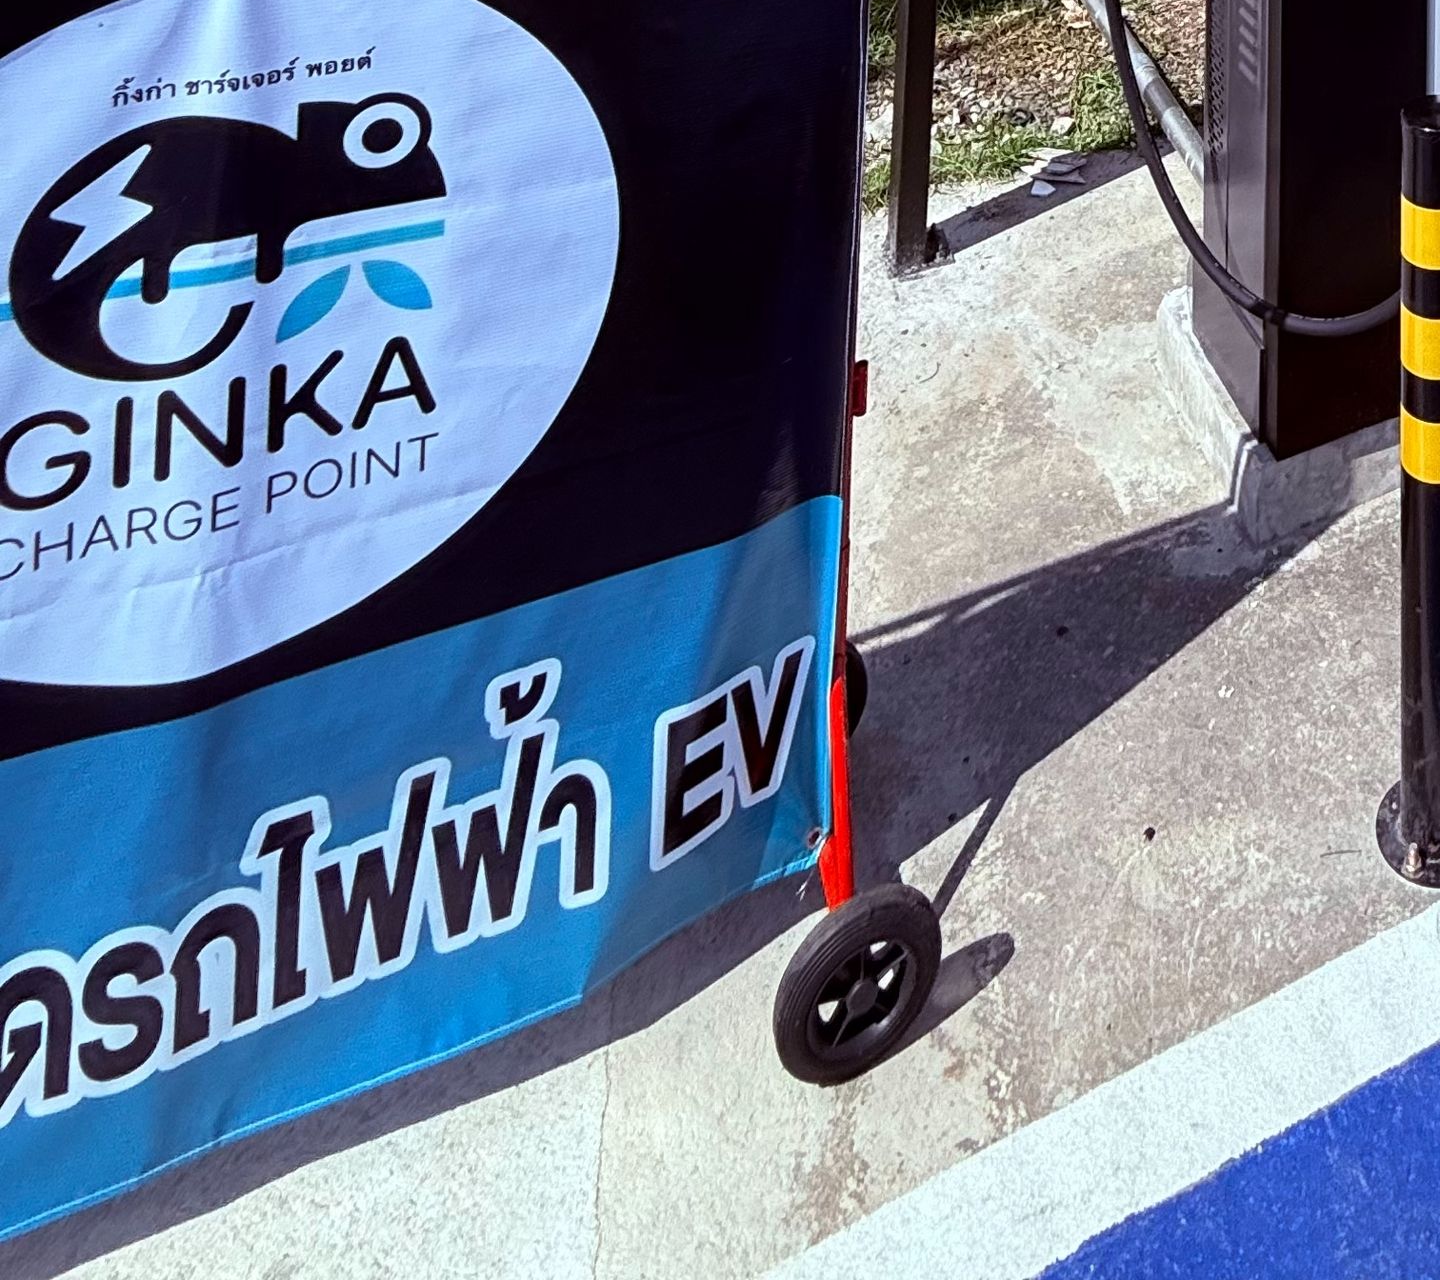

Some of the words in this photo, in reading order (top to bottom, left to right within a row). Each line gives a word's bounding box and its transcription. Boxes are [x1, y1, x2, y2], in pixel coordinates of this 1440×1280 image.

[112, 77, 177, 108] กิ้งก่า
[184, 56, 300, 96] ชาร์จเจอร์
[305, 46, 376, 78] พอยต์
[0, 336, 438, 512] GINKA
[0, 486, 241, 581] CHARGE
[265, 432, 440, 515] POINT
[657, 642, 808, 864] EV
